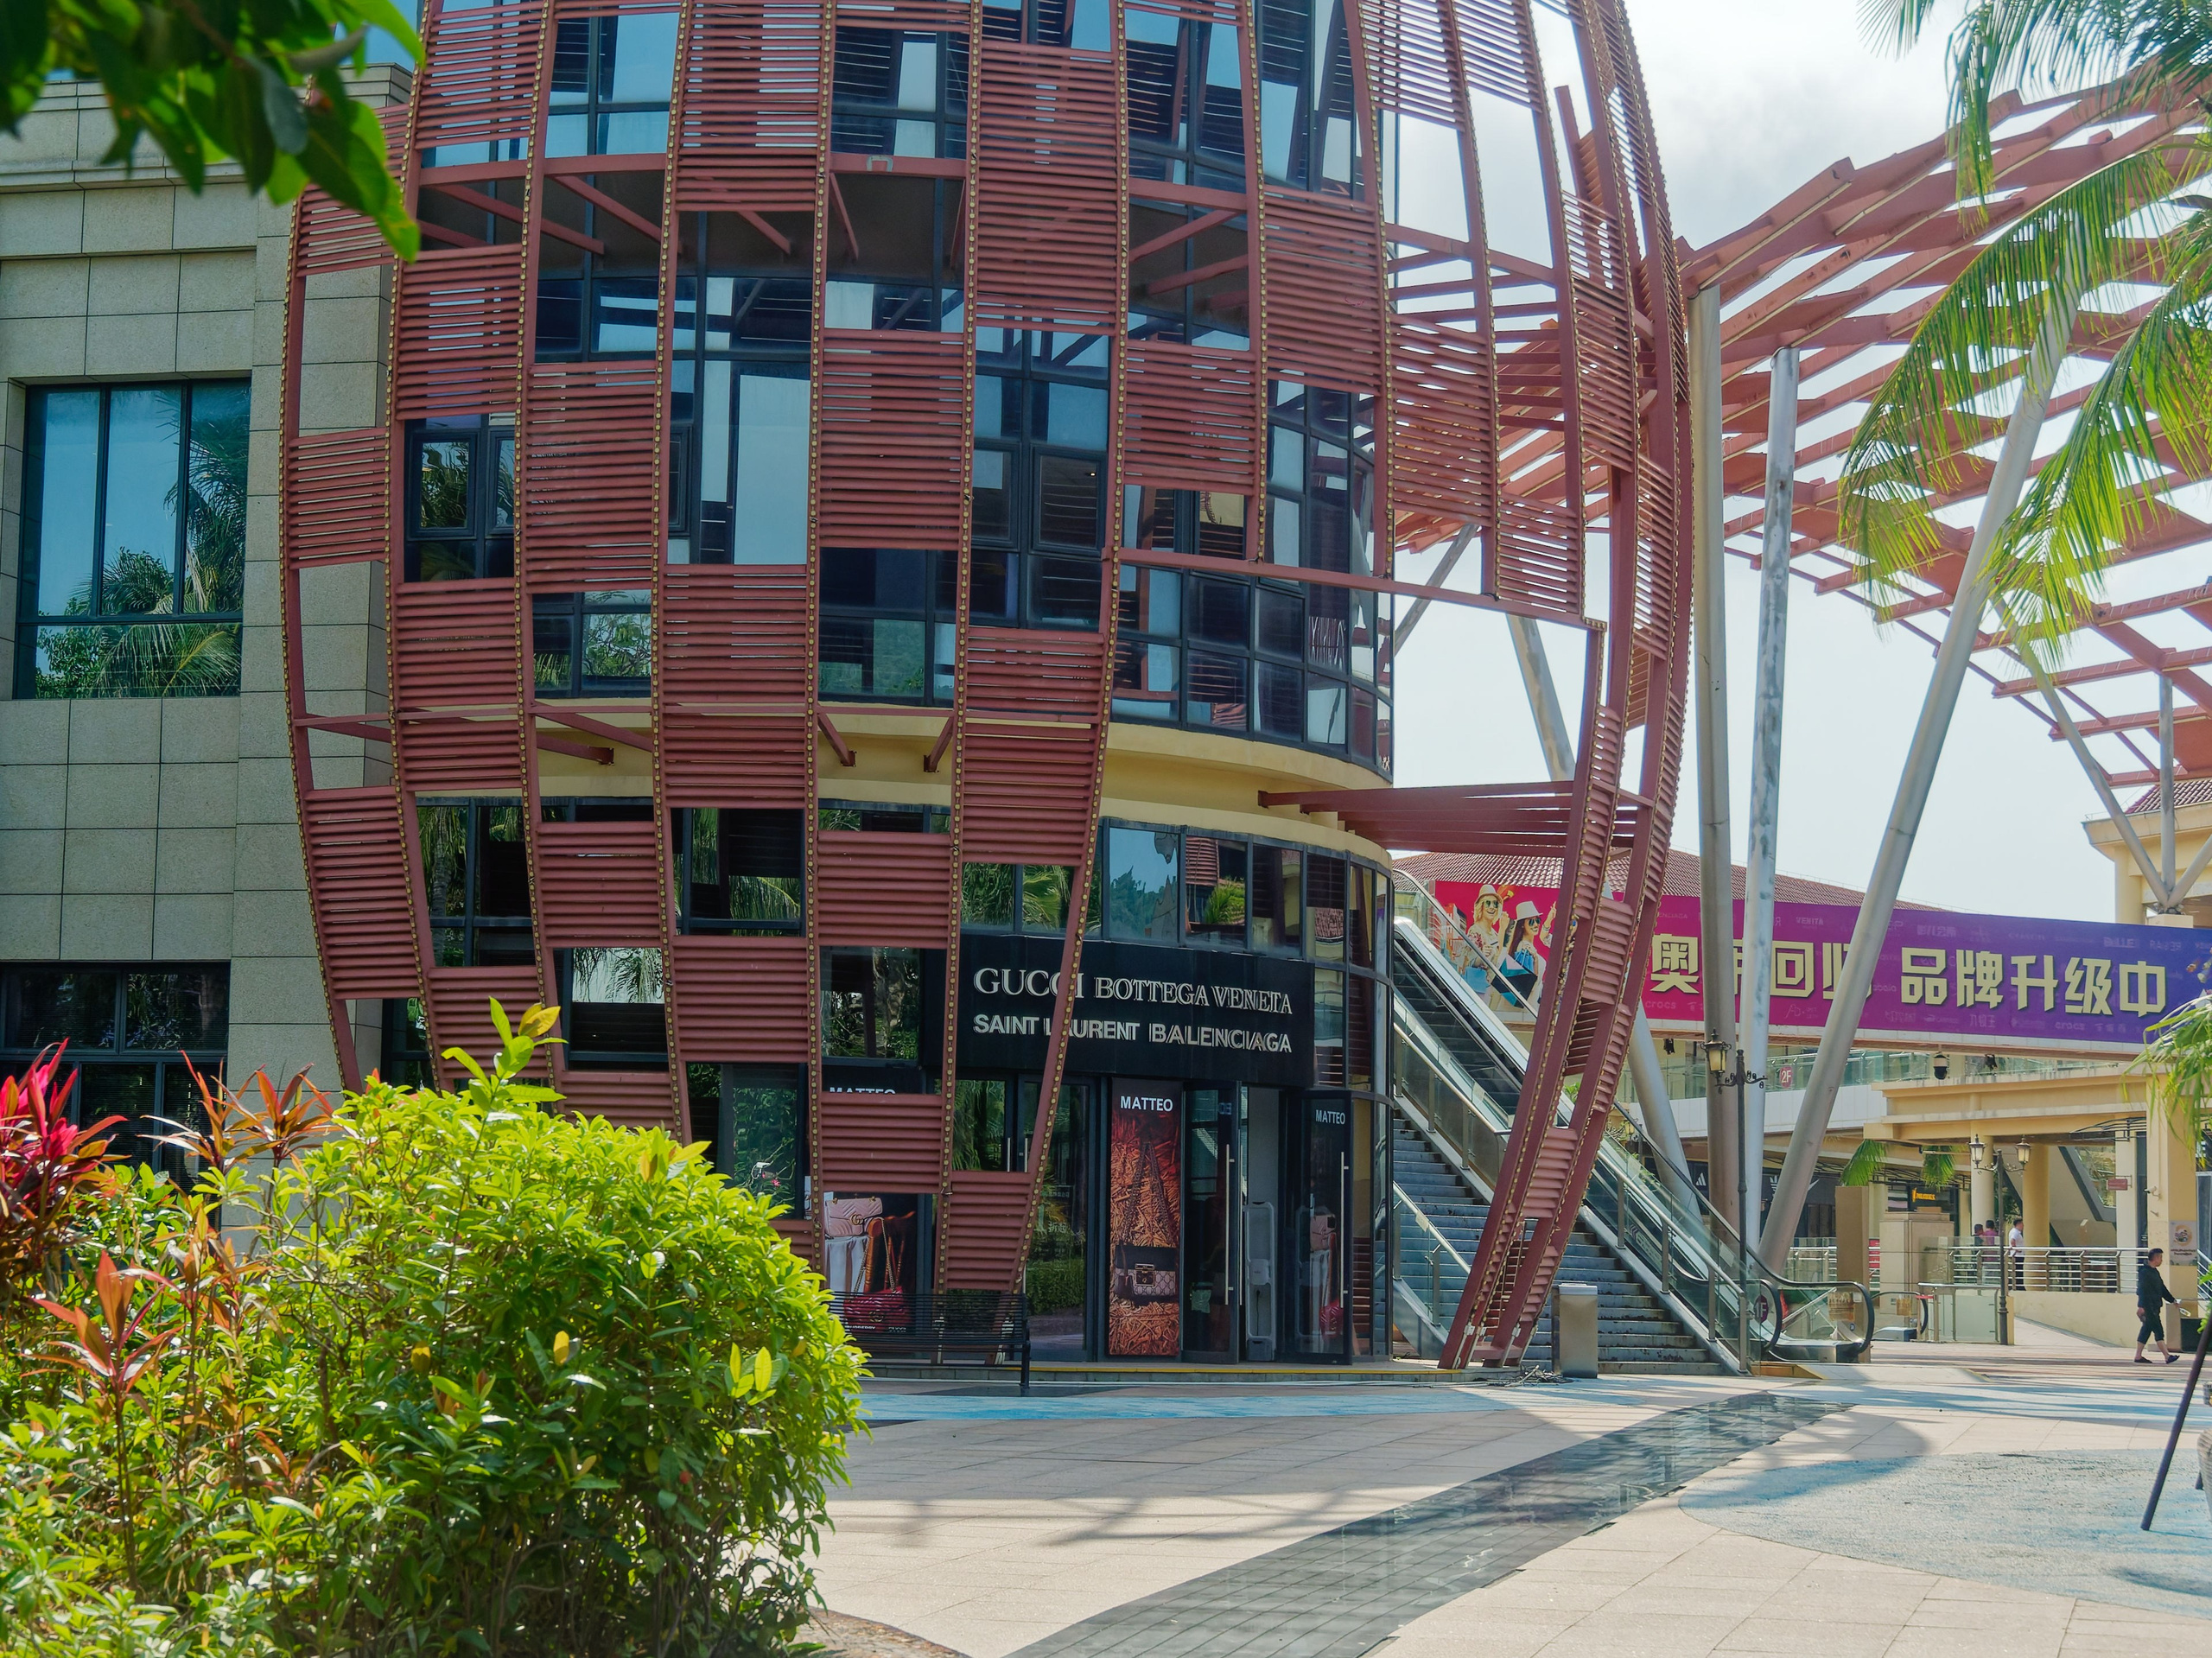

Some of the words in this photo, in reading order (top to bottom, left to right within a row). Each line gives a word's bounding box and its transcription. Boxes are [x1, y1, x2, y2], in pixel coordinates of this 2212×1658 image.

[1901, 947, 2168, 1018] 品牌升级中
[1094, 977, 1210, 1007] BOTTEGA
[1211, 986, 1293, 1015] VENETA
[1644, 1000, 1677, 1010] crocs
[973, 1013, 1039, 1035] SAINT
[1043, 1018, 1141, 1042] LURENT
[1148, 1022, 1293, 1053] BALENCIAGA
[2055, 1021, 2086, 1032] crocs
[1781, 1070, 1792, 1083] 2F
[1120, 1096, 1173, 1112] MATTEO
[1315, 1109, 1346, 1125] MATTEO
